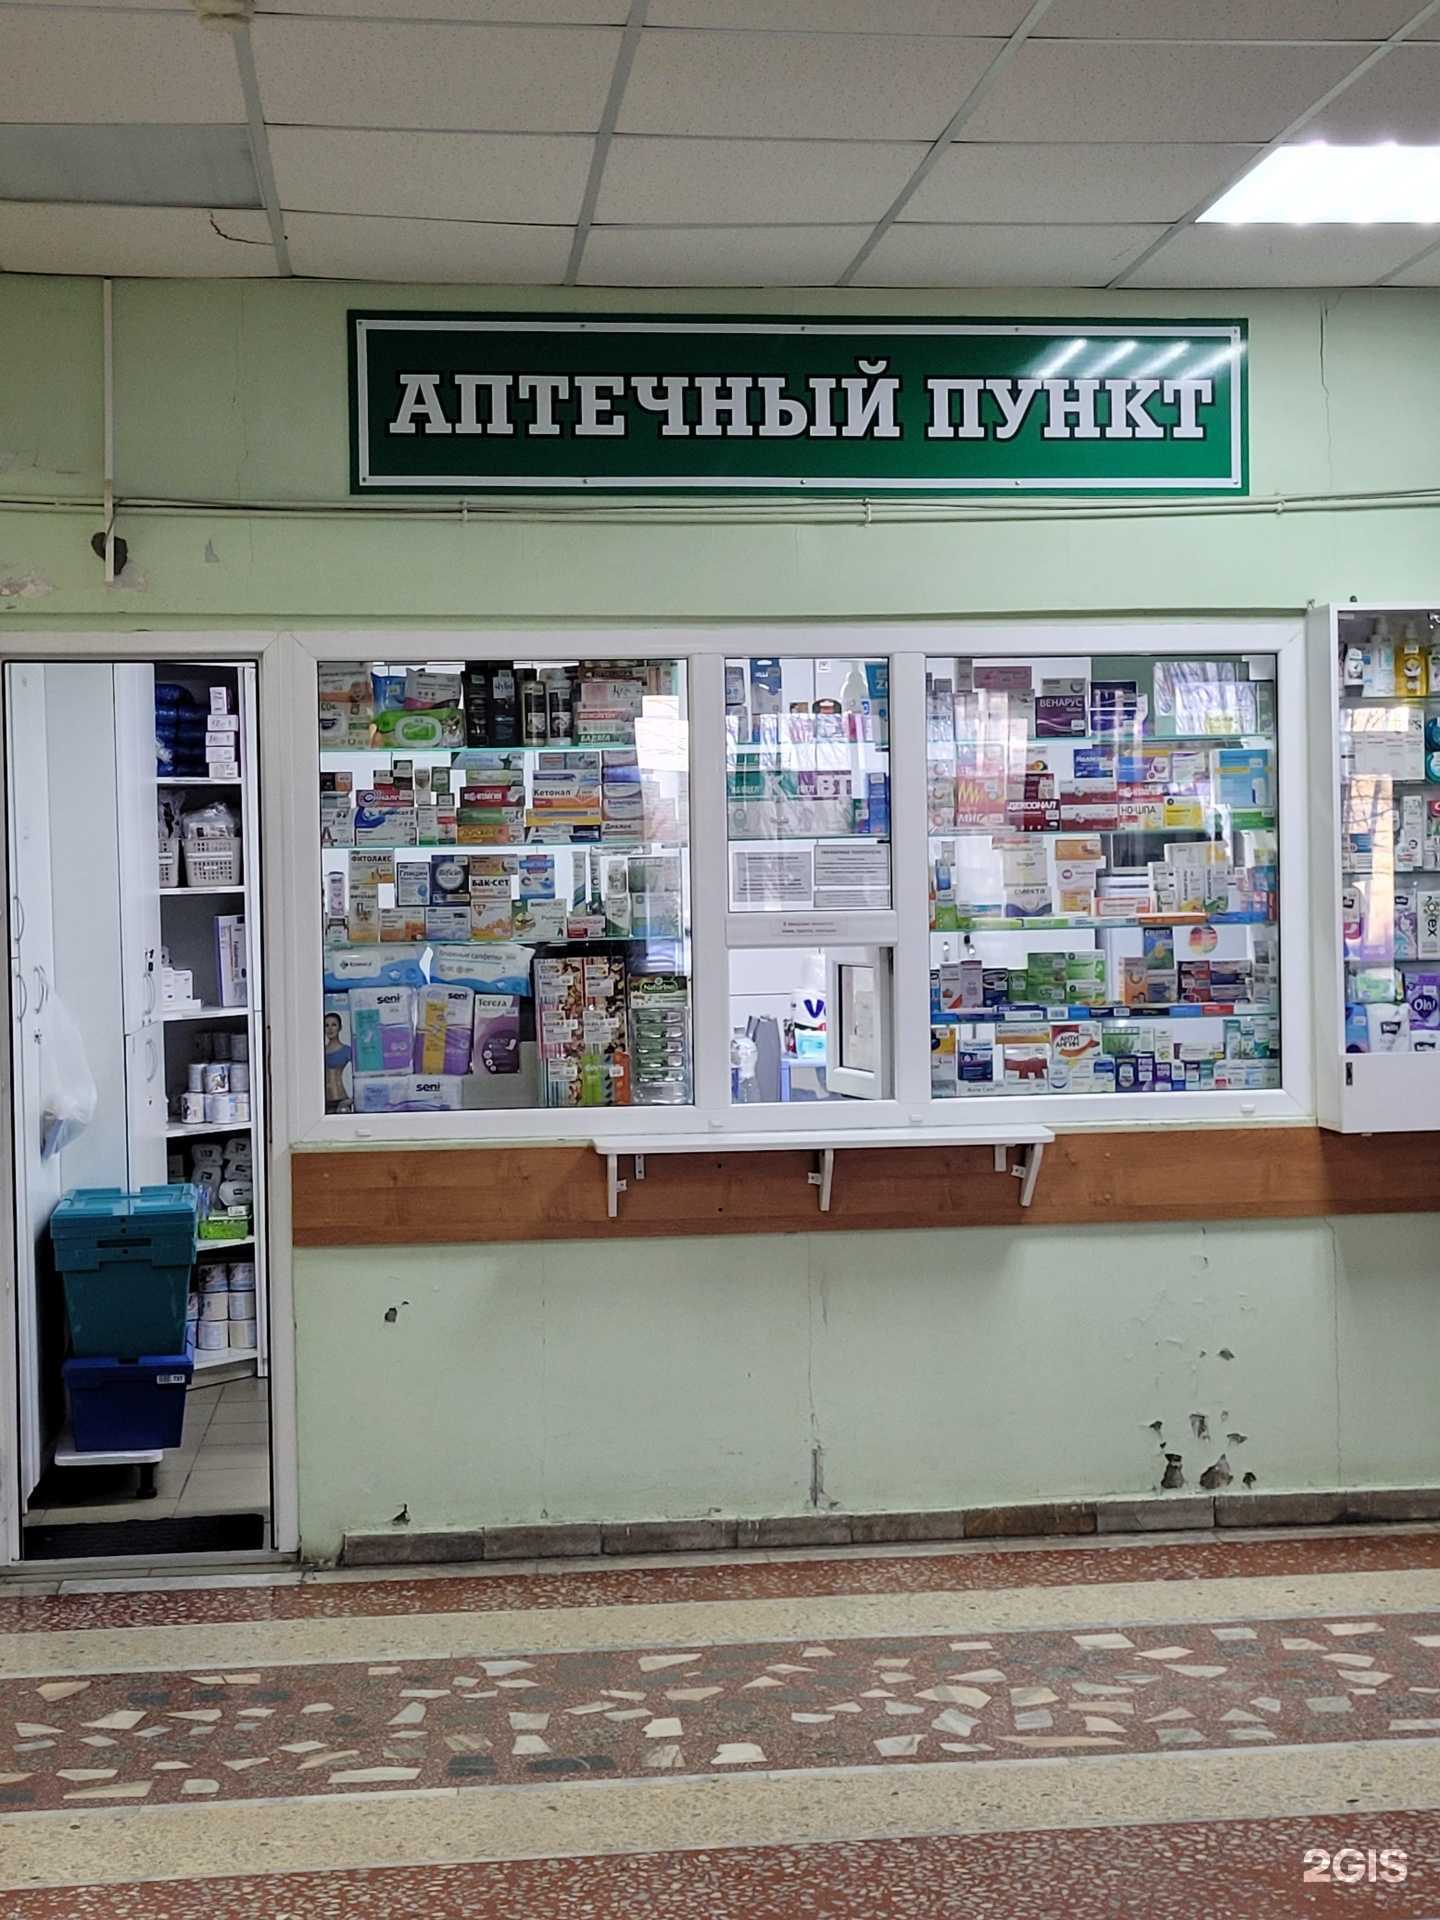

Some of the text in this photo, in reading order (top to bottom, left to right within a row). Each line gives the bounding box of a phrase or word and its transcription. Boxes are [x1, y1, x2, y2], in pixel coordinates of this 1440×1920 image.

[388, 359, 1213, 440] АПТЕЧНЫЙ ПУНКТ
[351, 855, 392, 863] ФИТОЛАКС
[377, 994, 400, 1004] seni
[447, 992, 468, 1001] seni
[416, 1082, 440, 1092] seni
